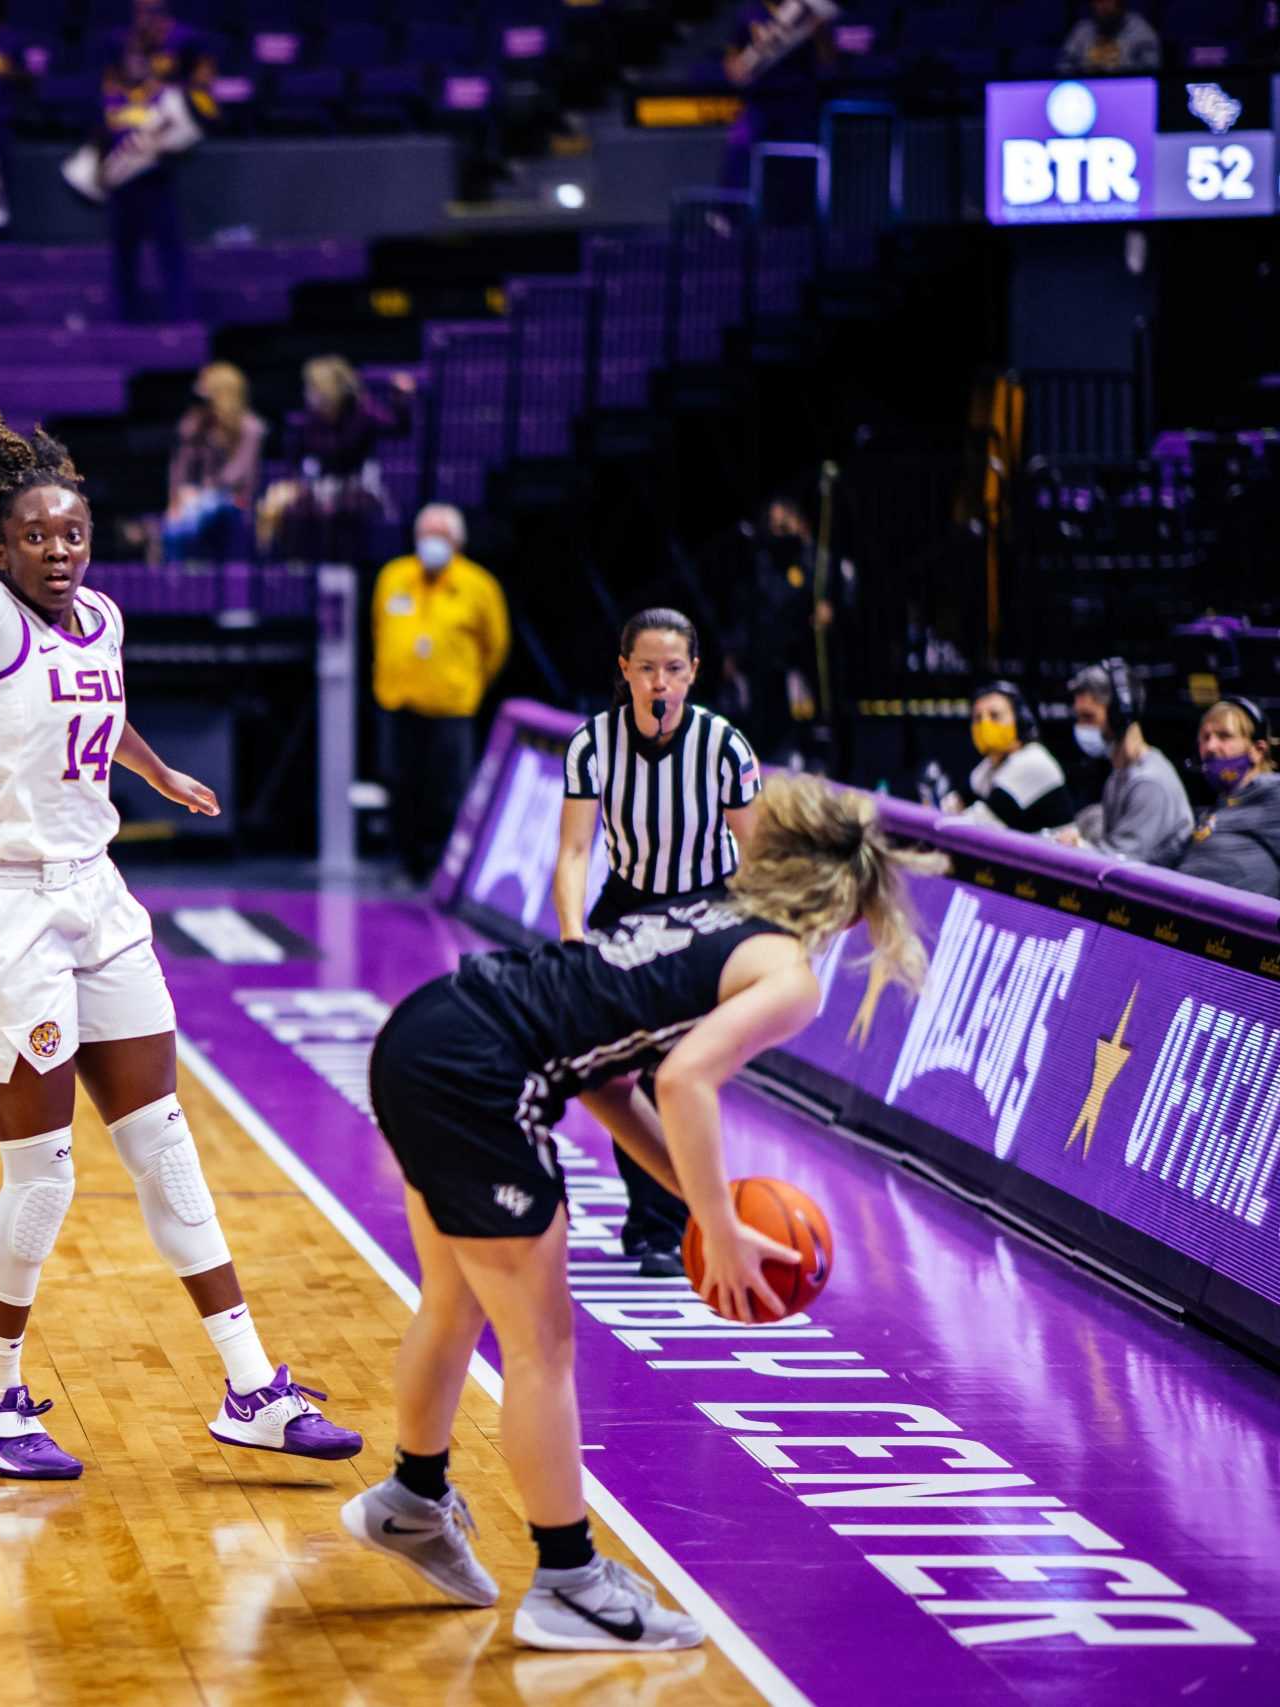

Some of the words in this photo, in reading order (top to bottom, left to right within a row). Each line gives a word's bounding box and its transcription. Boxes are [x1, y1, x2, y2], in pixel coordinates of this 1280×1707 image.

[1002, 136, 1140, 205] BTR
[1186, 144, 1254, 201] 52
[48, 668, 124, 703] LSU
[61, 714, 115, 782] 14
[694, 1402, 1257, 1646] CENTER
